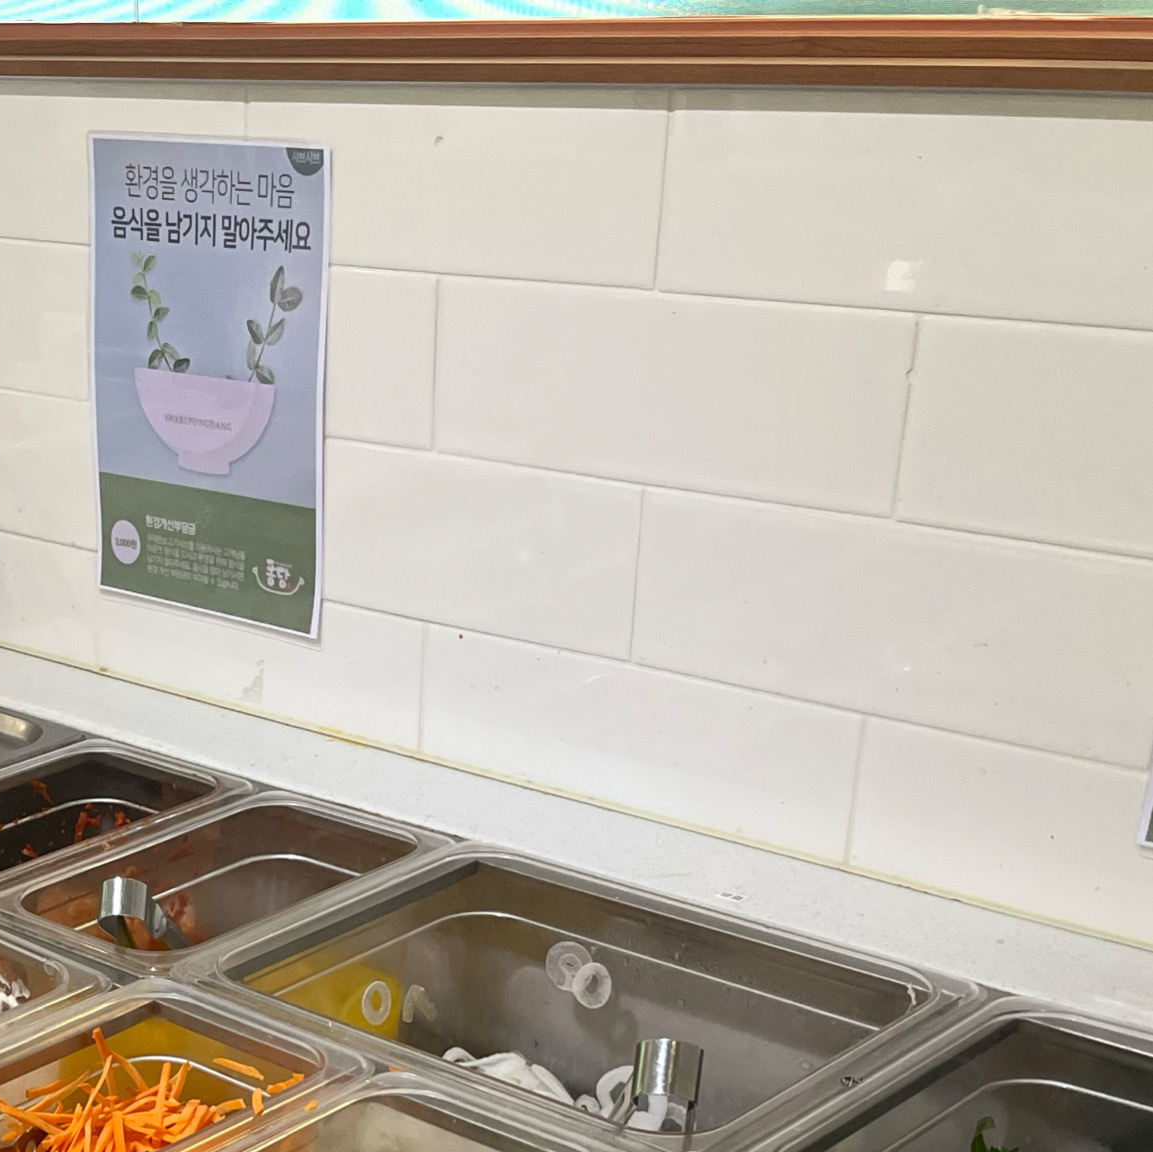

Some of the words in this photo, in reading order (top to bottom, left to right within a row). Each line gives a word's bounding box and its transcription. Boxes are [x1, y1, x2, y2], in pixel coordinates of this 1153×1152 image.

[125, 163, 177, 201] 환경을
[181, 167, 253, 206] 생각하는
[258, 171, 295, 209] 마음
[111, 206, 162, 242] 음식을
[165, 210, 216, 247] 남기지
[221, 214, 312, 253] 말아주세요
